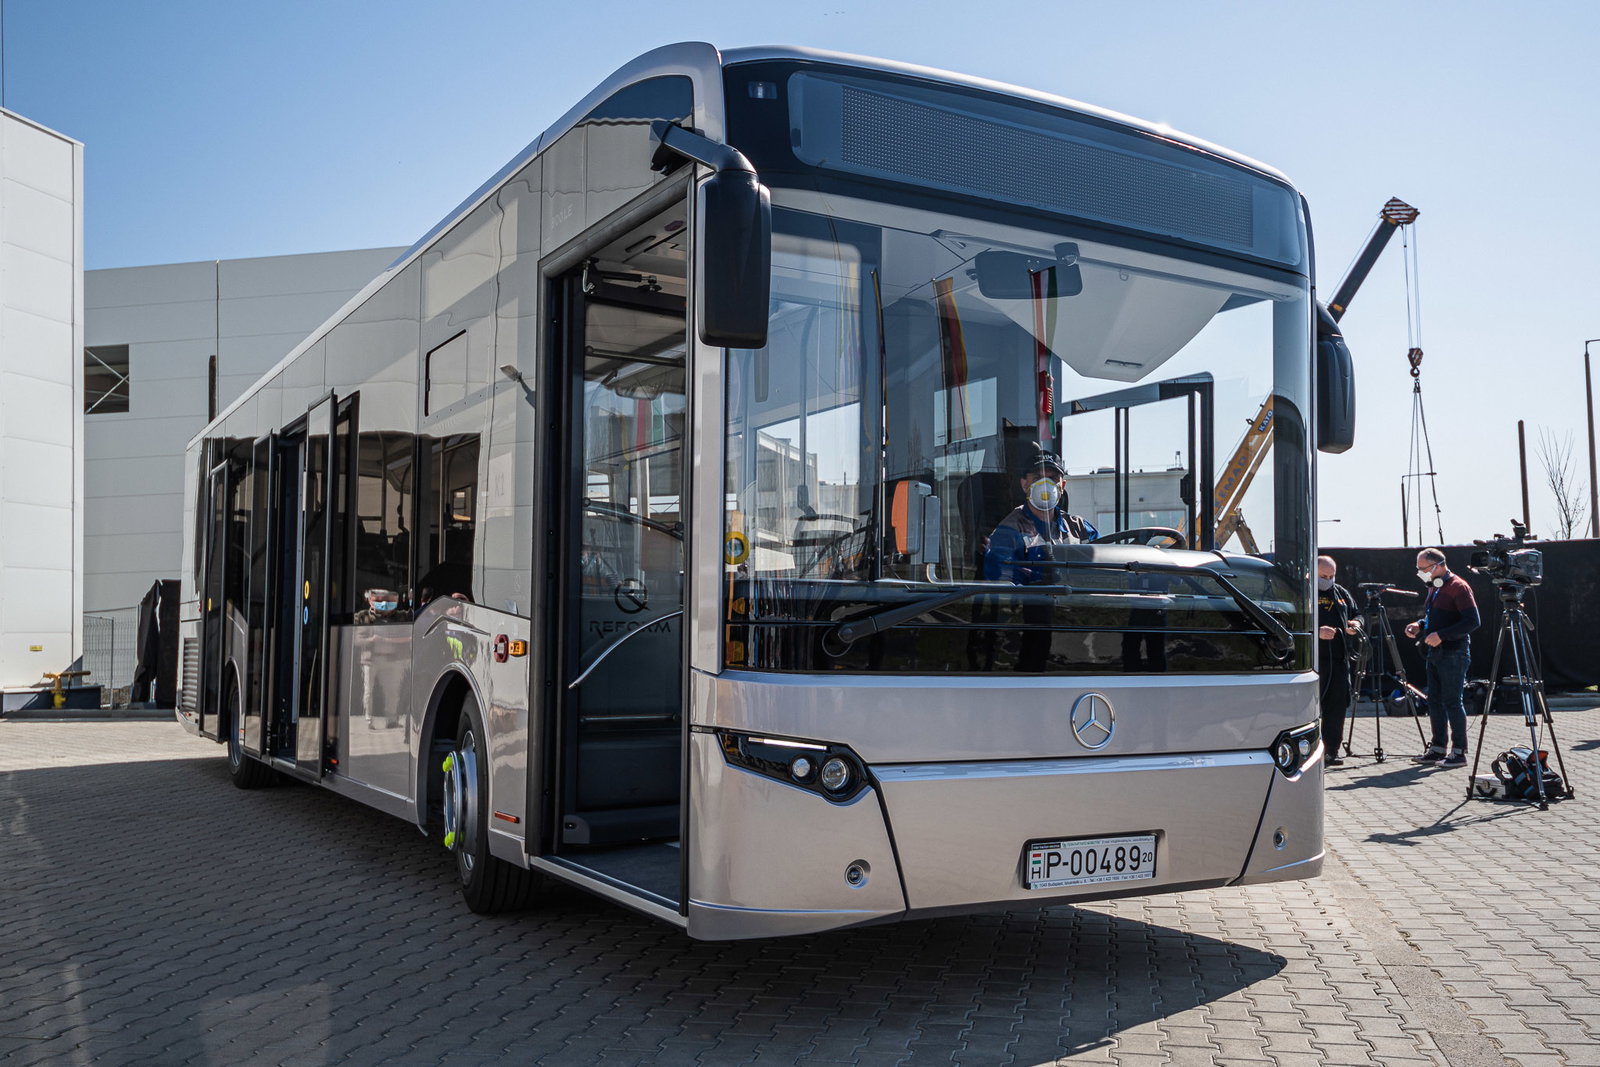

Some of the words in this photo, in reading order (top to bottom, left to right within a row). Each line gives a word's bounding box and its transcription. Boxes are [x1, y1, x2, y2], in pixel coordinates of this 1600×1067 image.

[1258, 410, 1273, 431] KATO
[589, 620, 671, 639] REFORM
[1031, 867, 1041, 879] H
[1046, 845, 1141, 878] P-00489
[1142, 851, 1153, 863] 20
